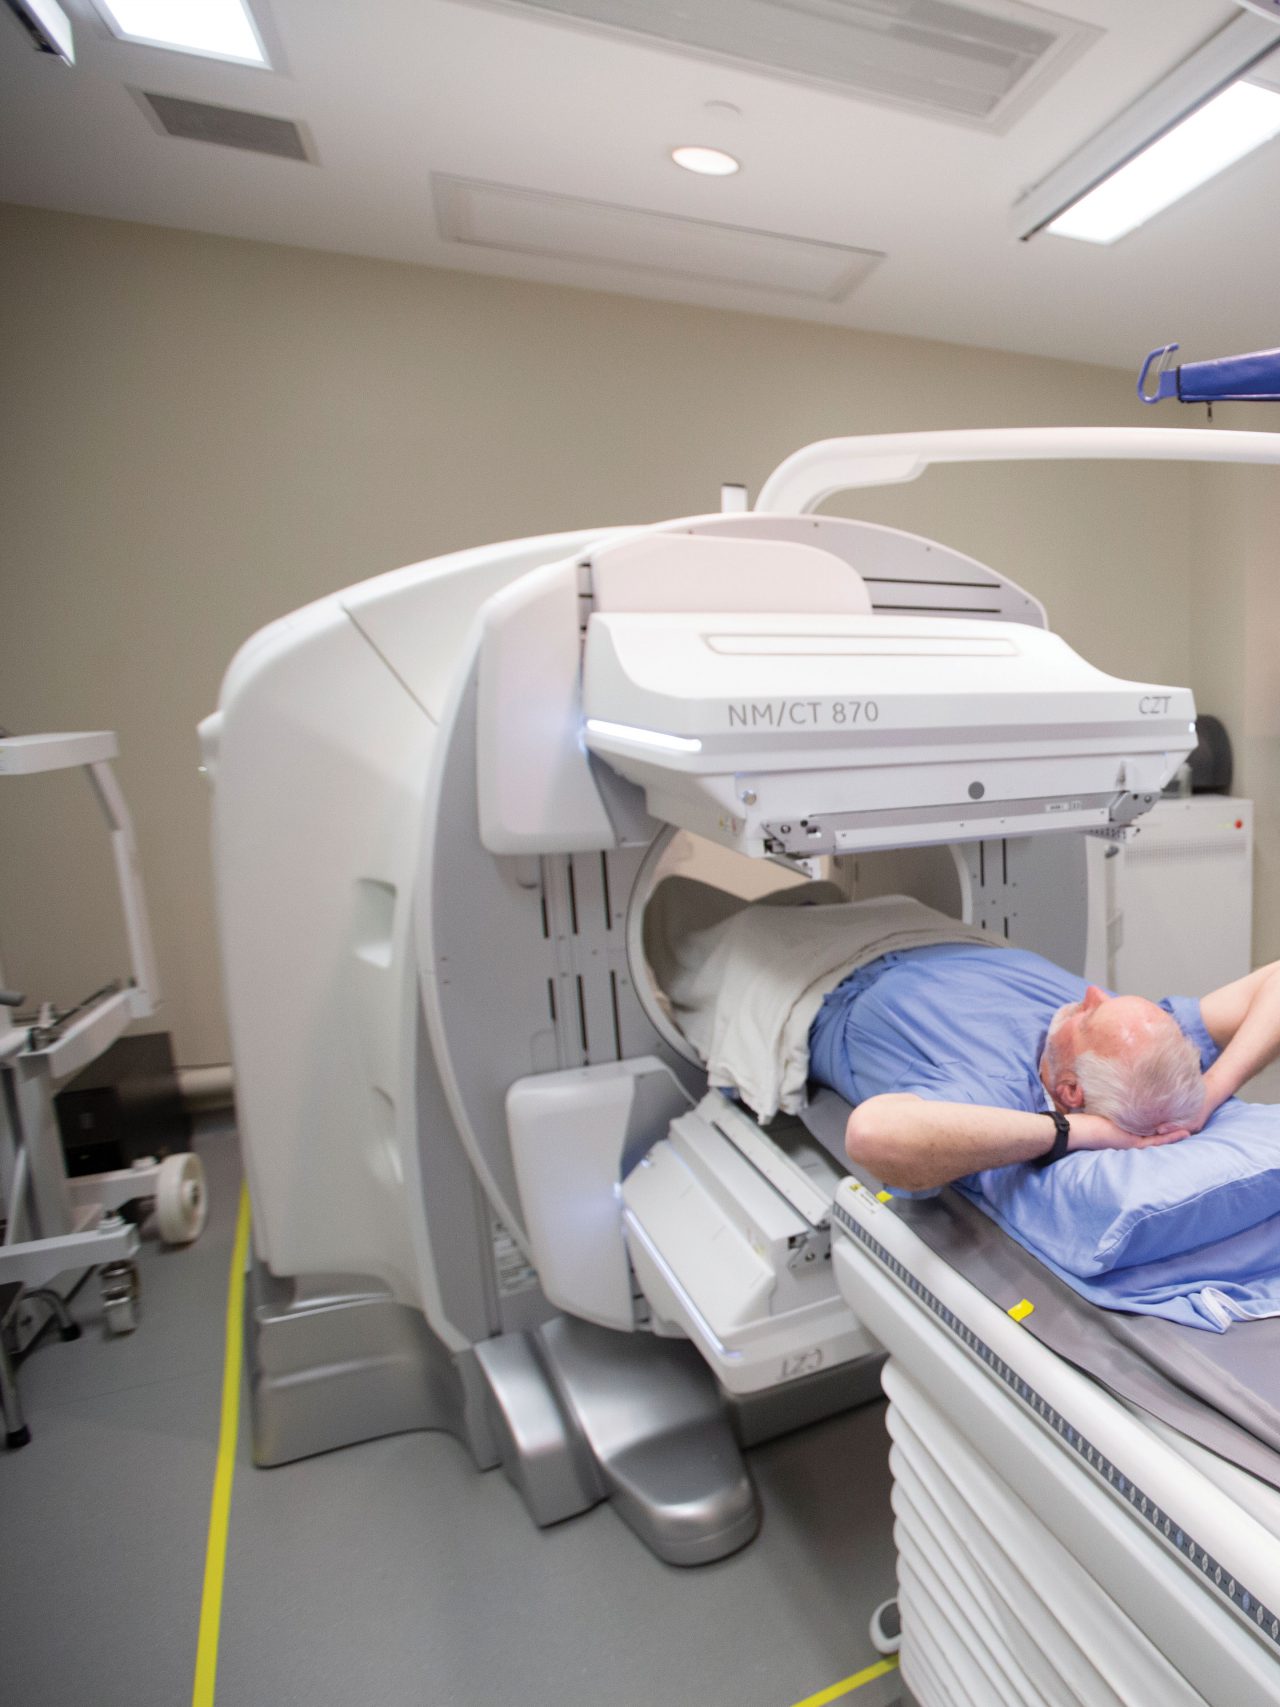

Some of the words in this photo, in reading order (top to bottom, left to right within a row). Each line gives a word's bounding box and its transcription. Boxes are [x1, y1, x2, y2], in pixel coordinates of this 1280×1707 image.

[728, 701, 822, 727] NM/CT
[832, 701, 879, 724] 870
[1138, 696, 1172, 715] CZT
